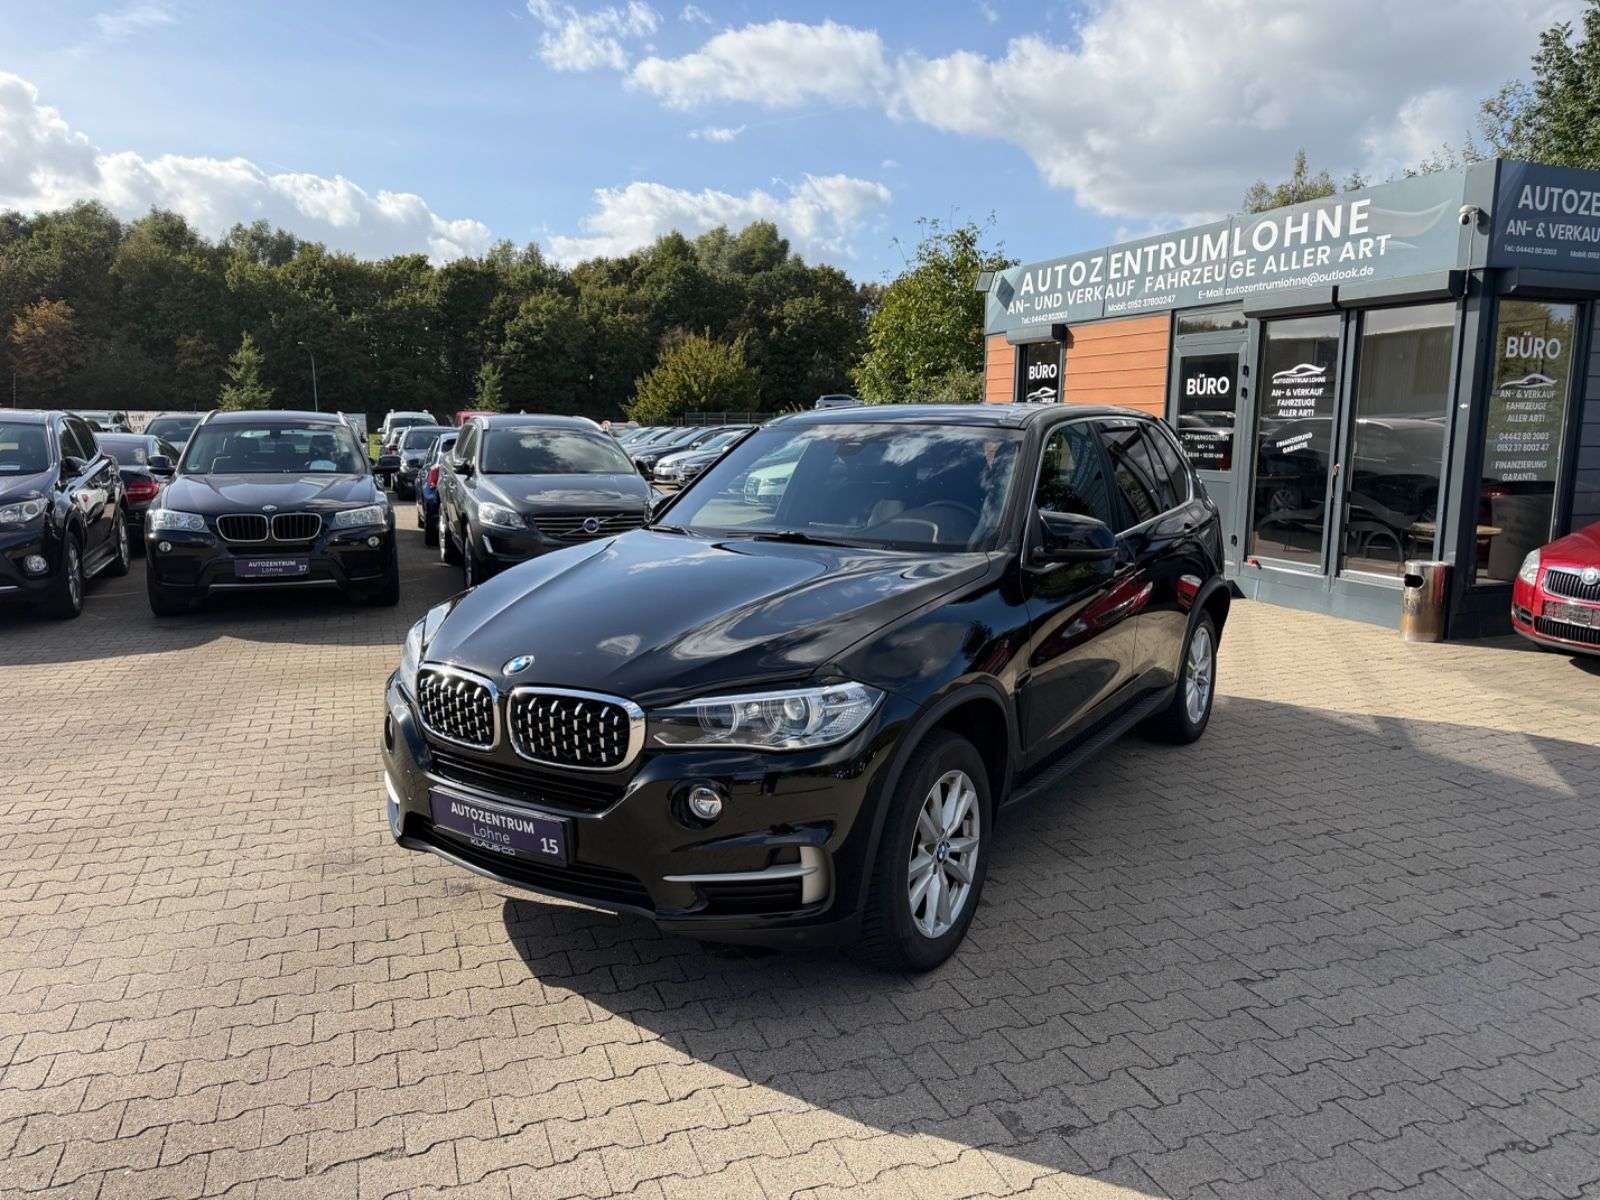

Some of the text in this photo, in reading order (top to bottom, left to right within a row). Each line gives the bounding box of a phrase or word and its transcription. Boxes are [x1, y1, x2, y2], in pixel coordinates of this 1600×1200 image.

[1506, 219, 1533, 236] AN-
[1535, 222, 1545, 238] &
[1007, 233, 1392, 315] AN- UND VERKAUF FAHRZEUGE ALLER ART
[1225, 265, 1375, 296] autozentrumlohne@outlook.de
[1505, 331, 1562, 359] BÜRO
[1029, 361, 1057, 380] BÜRO
[1186, 373, 1230, 395] BÜRO
[1285, 388, 1292, 397] &
[1292, 387, 1324, 396] VERKAUF
[1277, 398, 1315, 407] FAHRZEUGE
[1516, 389, 1523, 398] &
[1524, 390, 1556, 399] VERKAUF
[1278, 408, 1297, 417] ALLER
[1506, 401, 1546, 410] FAHRZEUGE
[1506, 414, 1528, 422] ALLER
[248, 560, 296, 568] AUTOZENTRUM
[451, 801, 535, 834] AUTOZENTRUM
[472, 822, 511, 845] Lohne
[540, 837, 559, 855] 15
